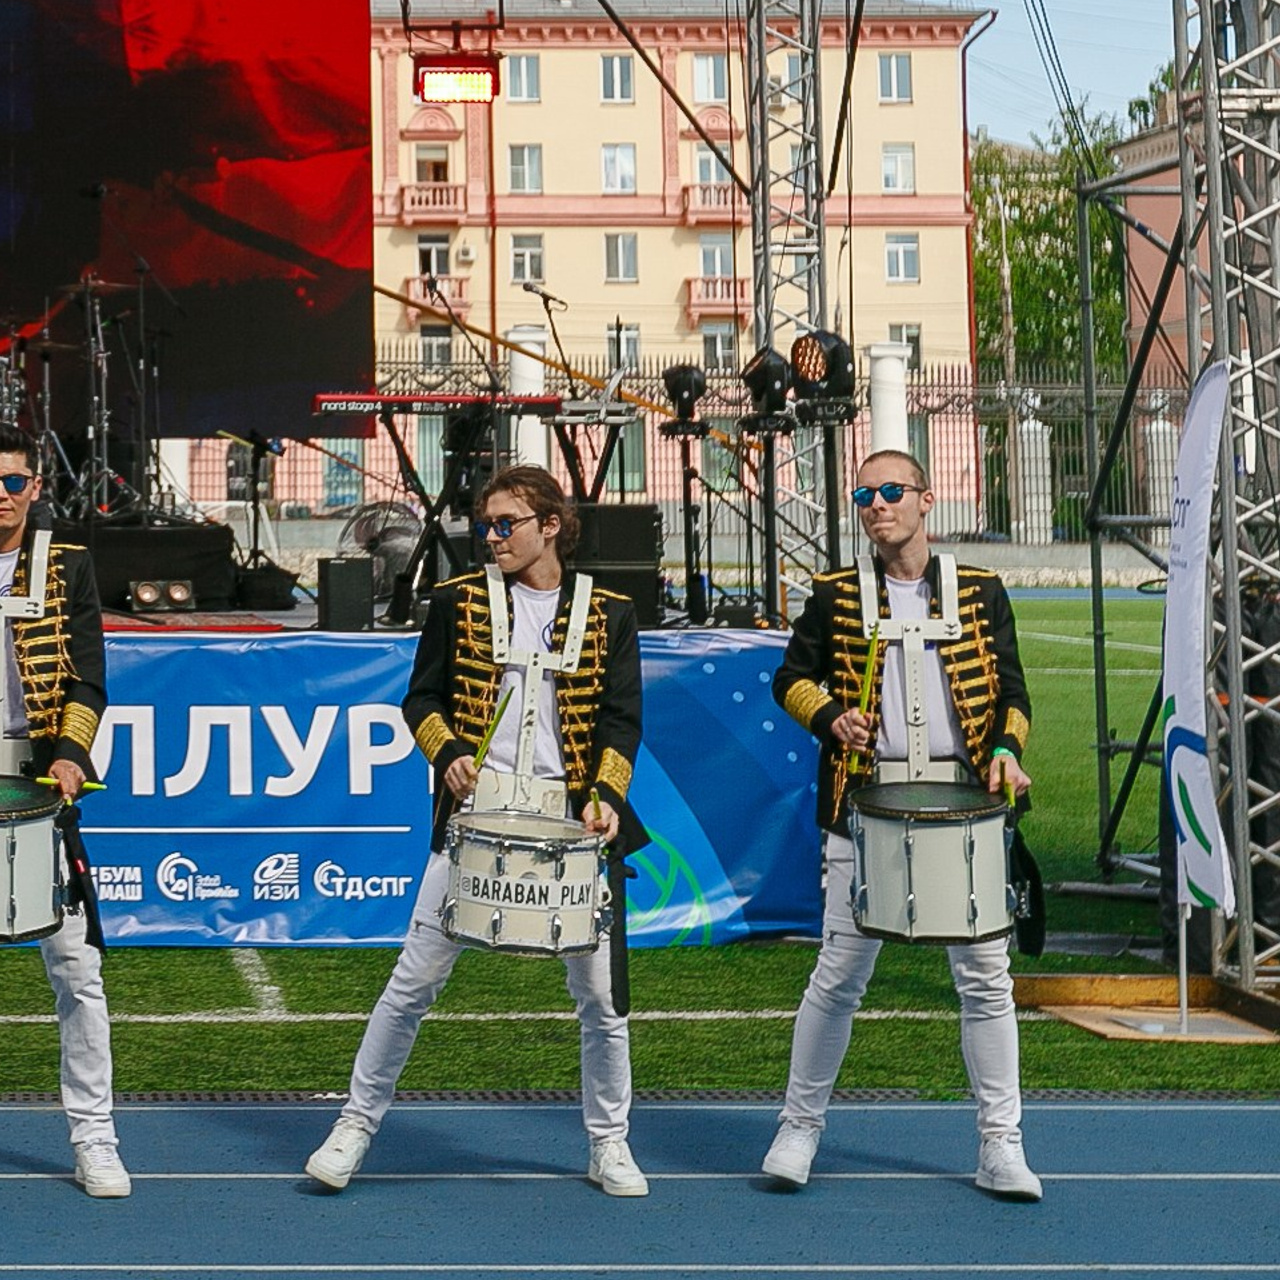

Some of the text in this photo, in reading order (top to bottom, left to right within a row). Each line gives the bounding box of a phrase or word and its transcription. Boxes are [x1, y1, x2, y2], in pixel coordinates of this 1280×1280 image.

[98, 866, 142, 883] БУМ
[98, 884, 142, 901] МАШ
[253, 884, 300, 901] ИЗИ
